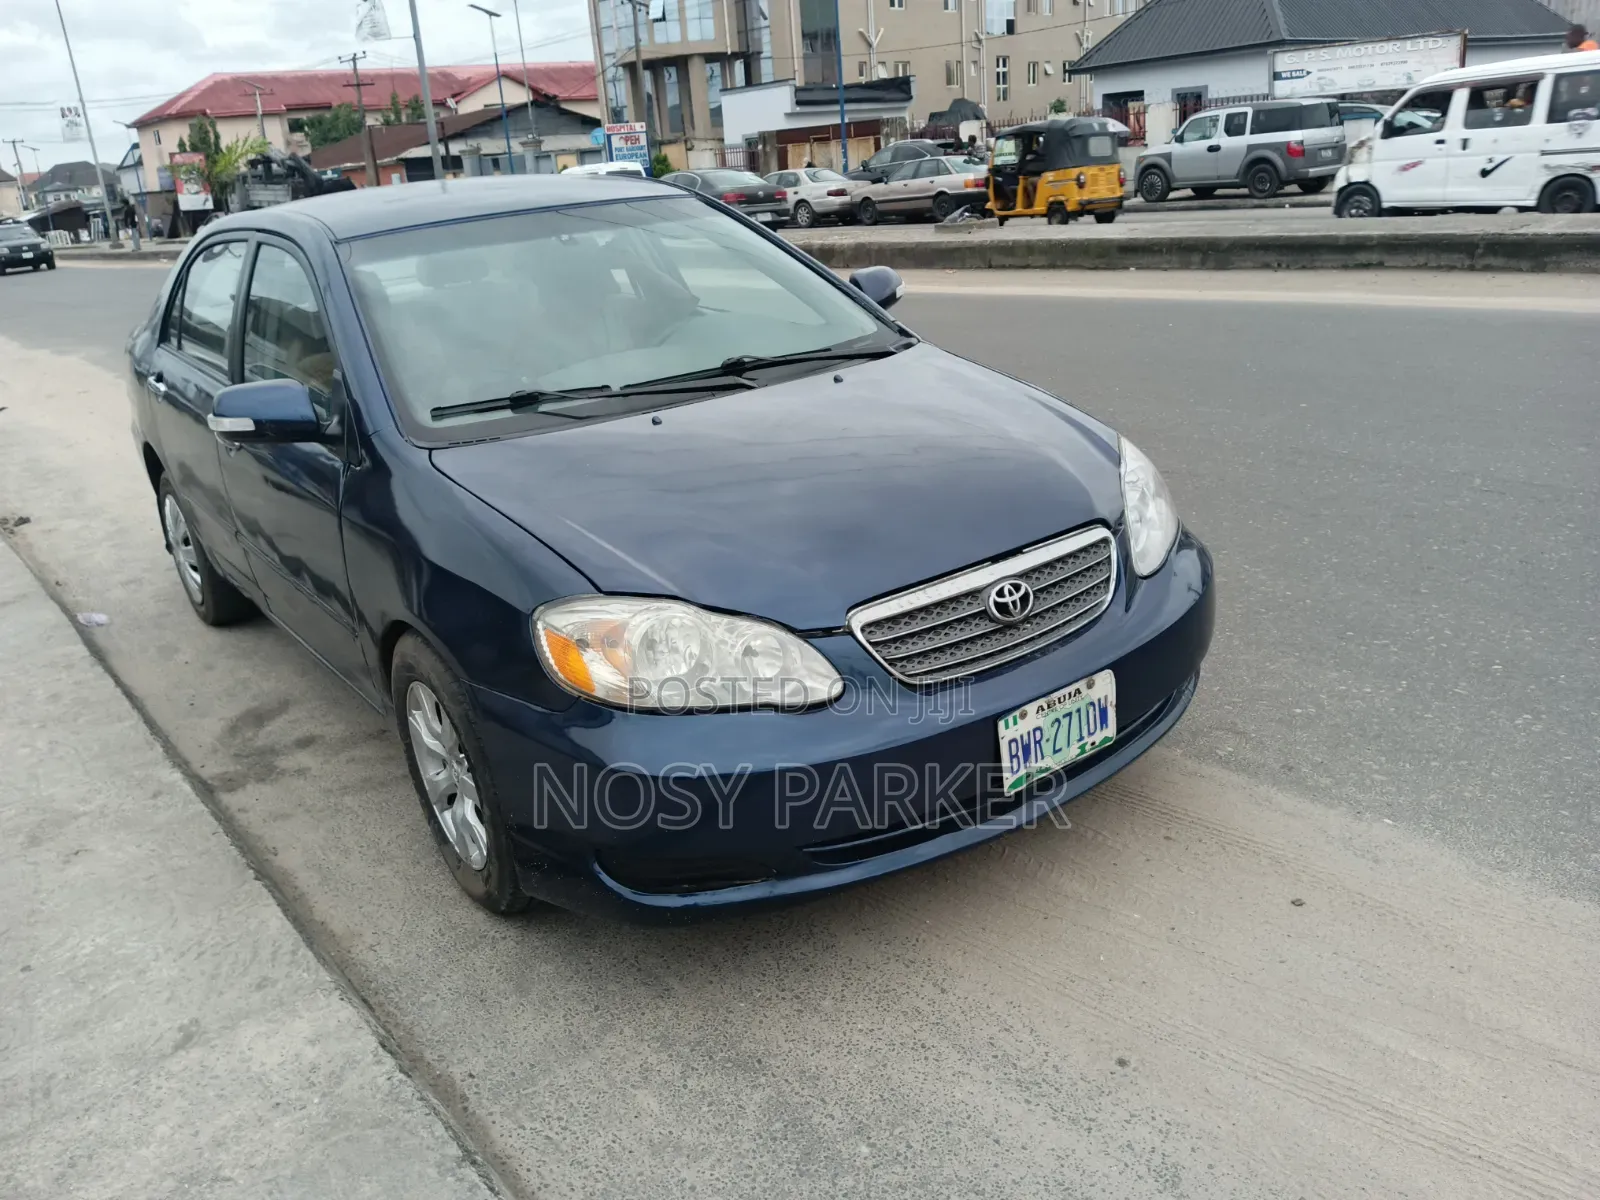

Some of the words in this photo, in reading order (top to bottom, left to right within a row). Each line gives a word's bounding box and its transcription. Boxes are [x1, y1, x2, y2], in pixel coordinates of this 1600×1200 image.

[1336, 42, 1401, 59] MOTOR
[606, 124, 636, 132] HOSPITAL
[615, 152, 647, 160] EUROPEAN
[1035, 687, 1082, 714] ABUJA
